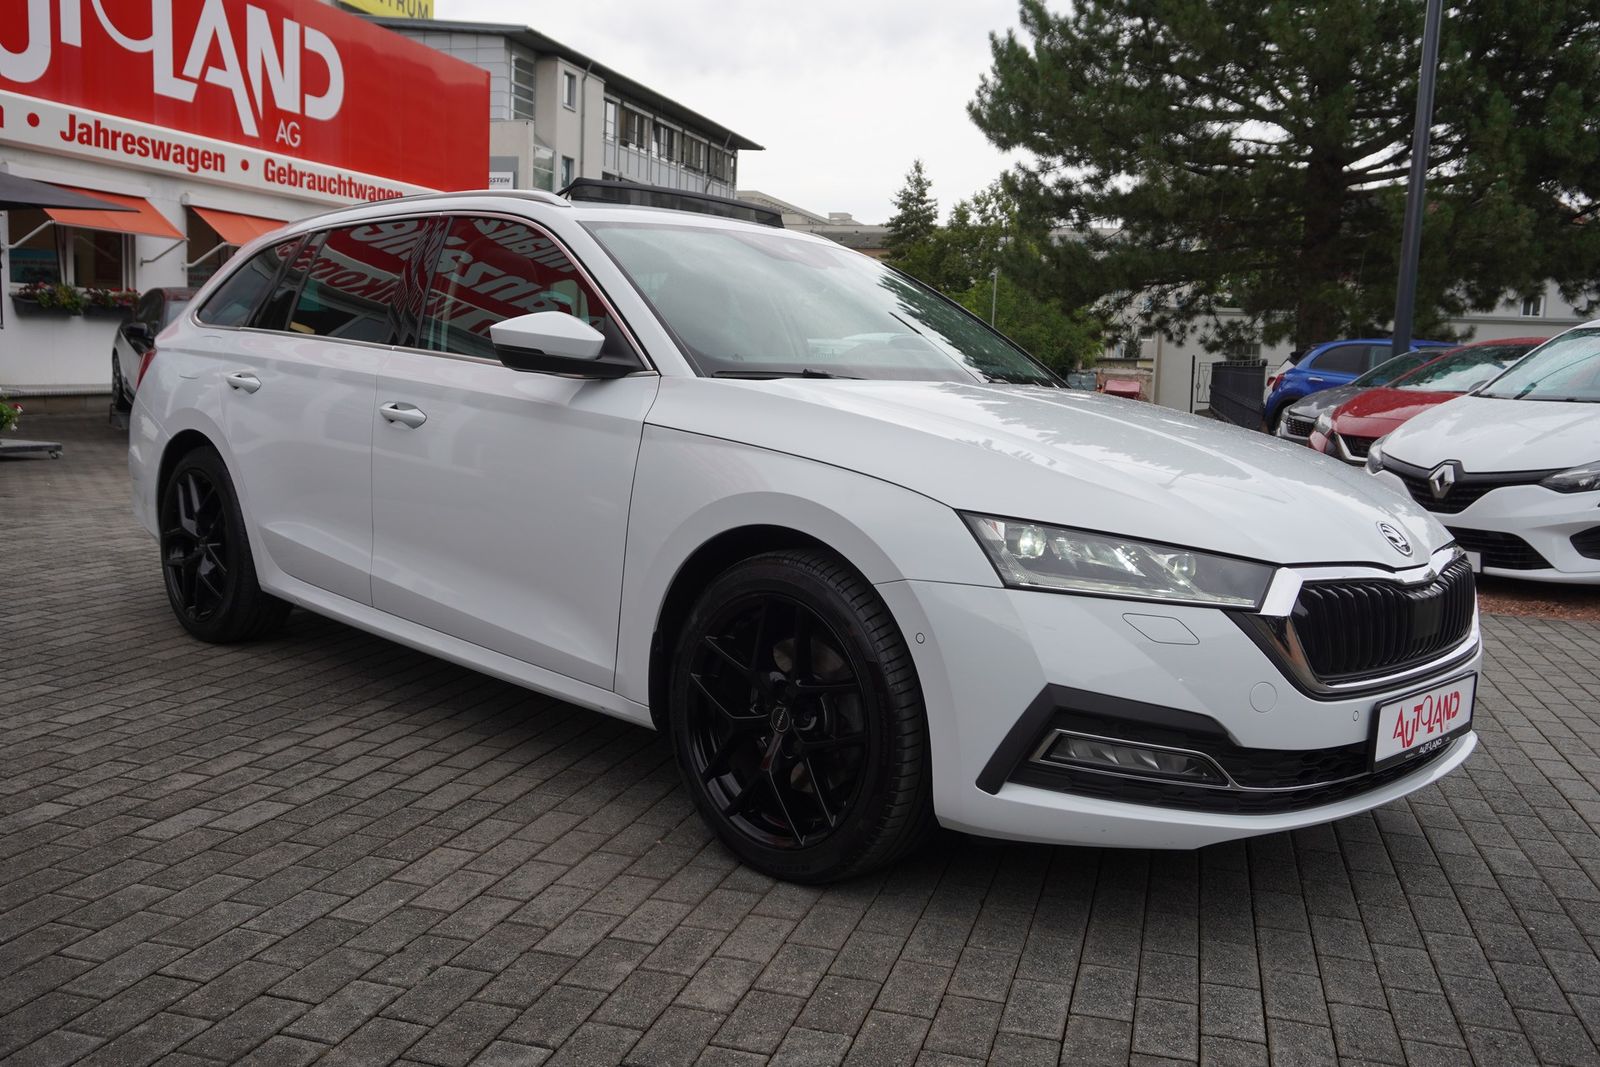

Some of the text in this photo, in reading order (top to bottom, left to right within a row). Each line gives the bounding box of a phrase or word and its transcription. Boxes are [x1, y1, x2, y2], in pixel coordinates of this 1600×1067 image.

[60, 113, 226, 173] Jahreswagen
[264, 158, 403, 202] Gebrauchtwagen
[275, 119, 301, 147] AG
[1392, 690, 1460, 748] AUTOLAND
